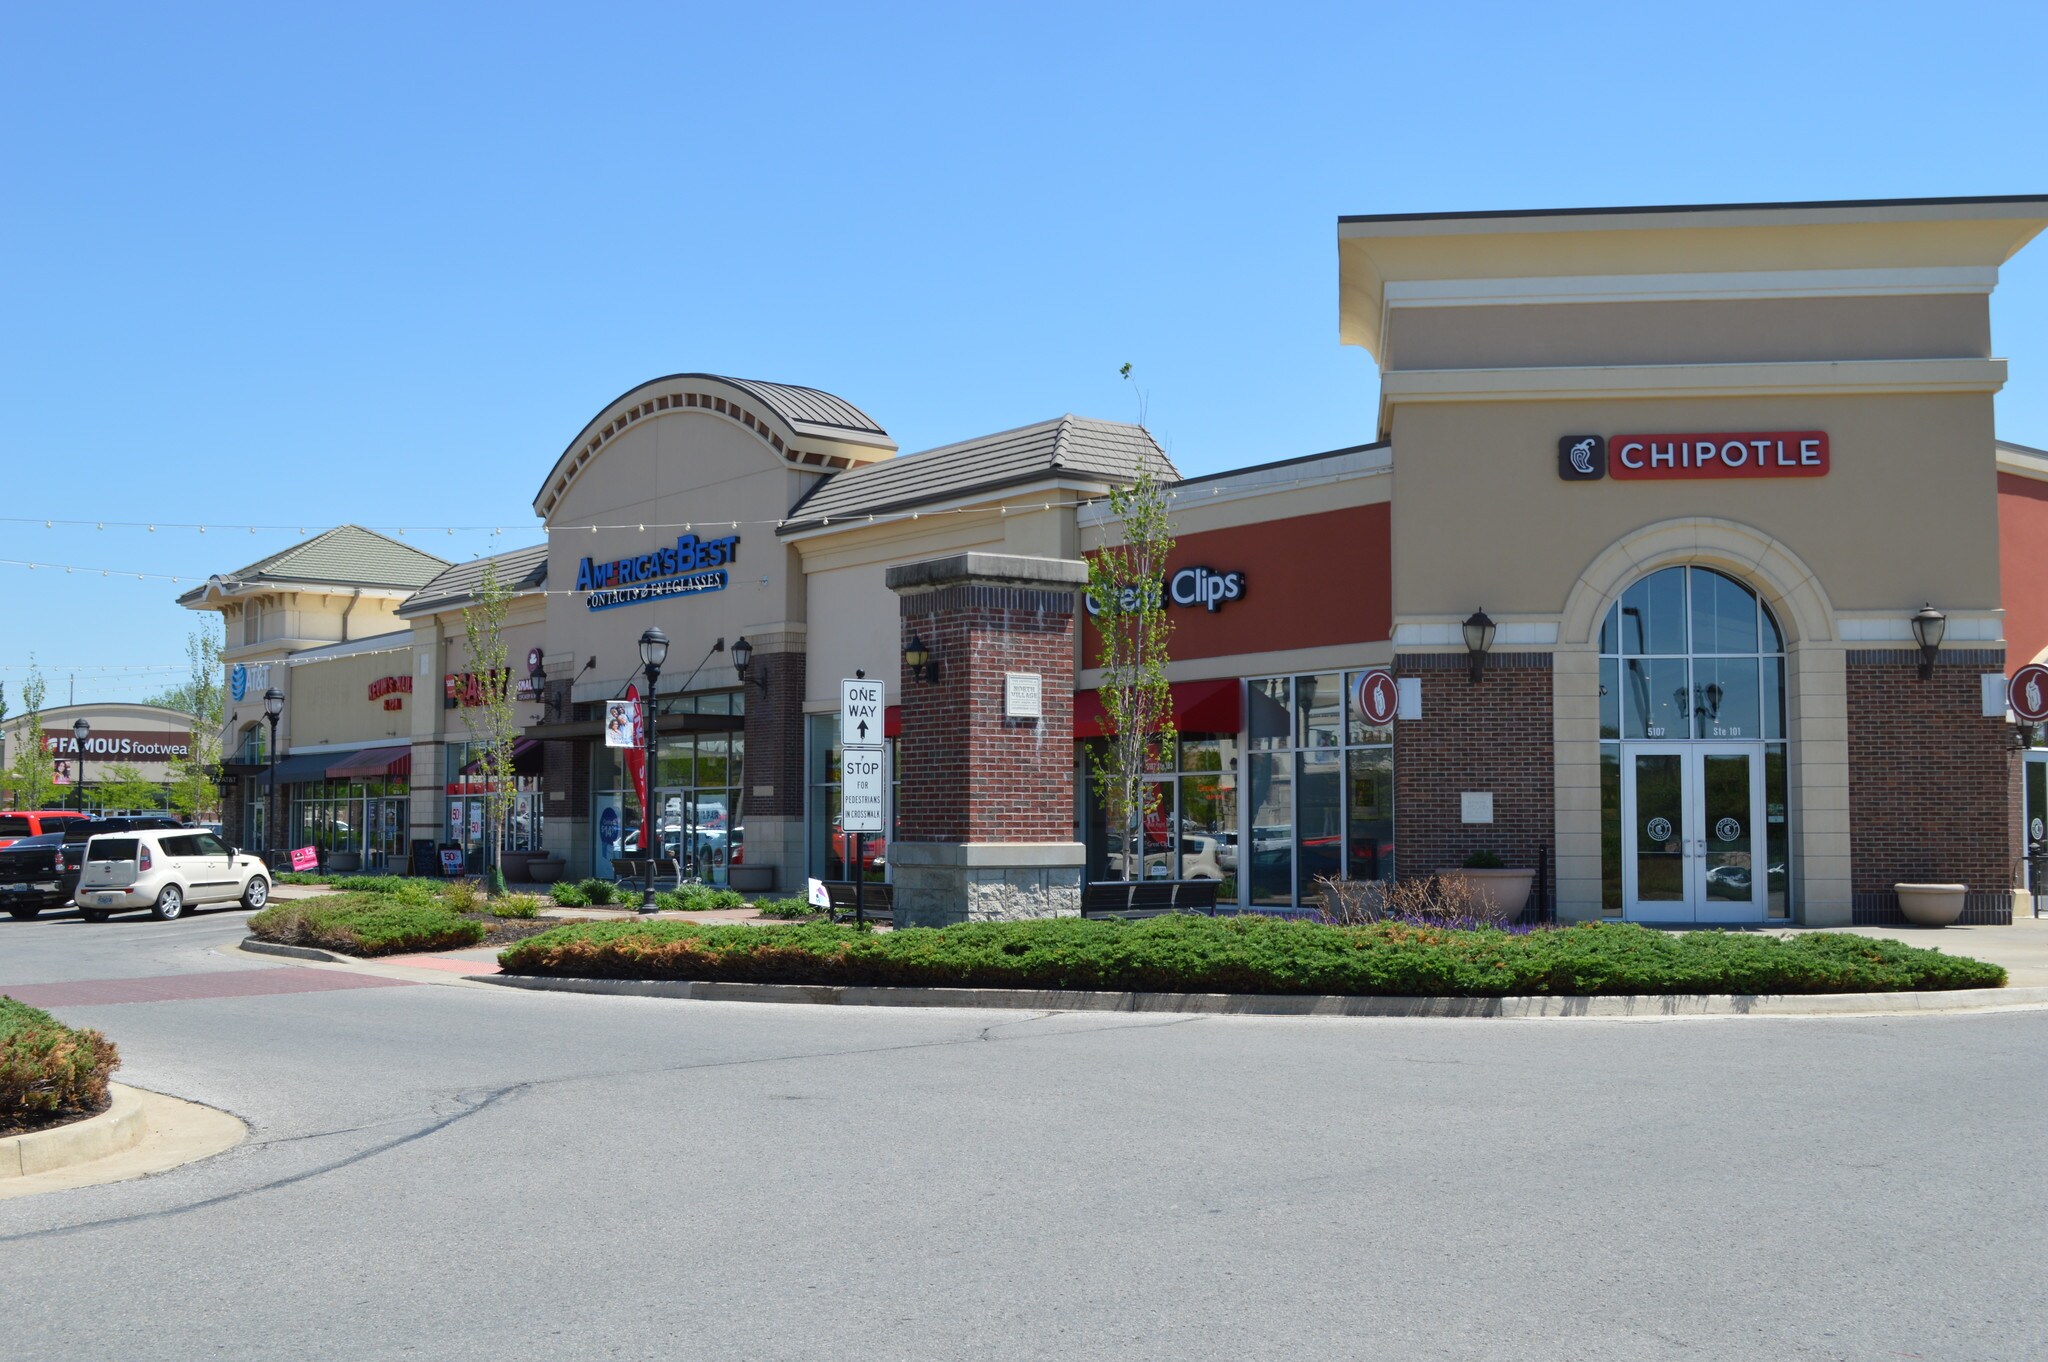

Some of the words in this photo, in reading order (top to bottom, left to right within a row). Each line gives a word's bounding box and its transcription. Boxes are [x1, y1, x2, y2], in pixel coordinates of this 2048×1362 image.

[1620, 440, 1821, 468] CHIPOTLE
[574, 547, 678, 591] AMERICA'S
[677, 534, 740, 573] BEST
[585, 588, 638, 609] CONTACTS
[640, 583, 649, 600] &
[651, 572, 721, 596] EYEGLASSES
[1171, 568, 1239, 611] Clips
[245, 665, 271, 692] AT&T
[849, 688, 876, 701] ONE
[849, 705, 877, 717] WAY
[1648, 728, 1665, 736] 5107
[1713, 728, 1726, 736] Ste
[1729, 727, 1741, 736] 101
[59, 737, 131, 754] FAMOUS
[132, 742, 187, 755] footwea
[847, 762, 879, 775] STOP
[857, 781, 868, 789] FOR
[845, 796, 880, 804] PEDESTRIANS
[845, 810, 850, 818] IN
[851, 810, 880, 818] CROSSWALK
